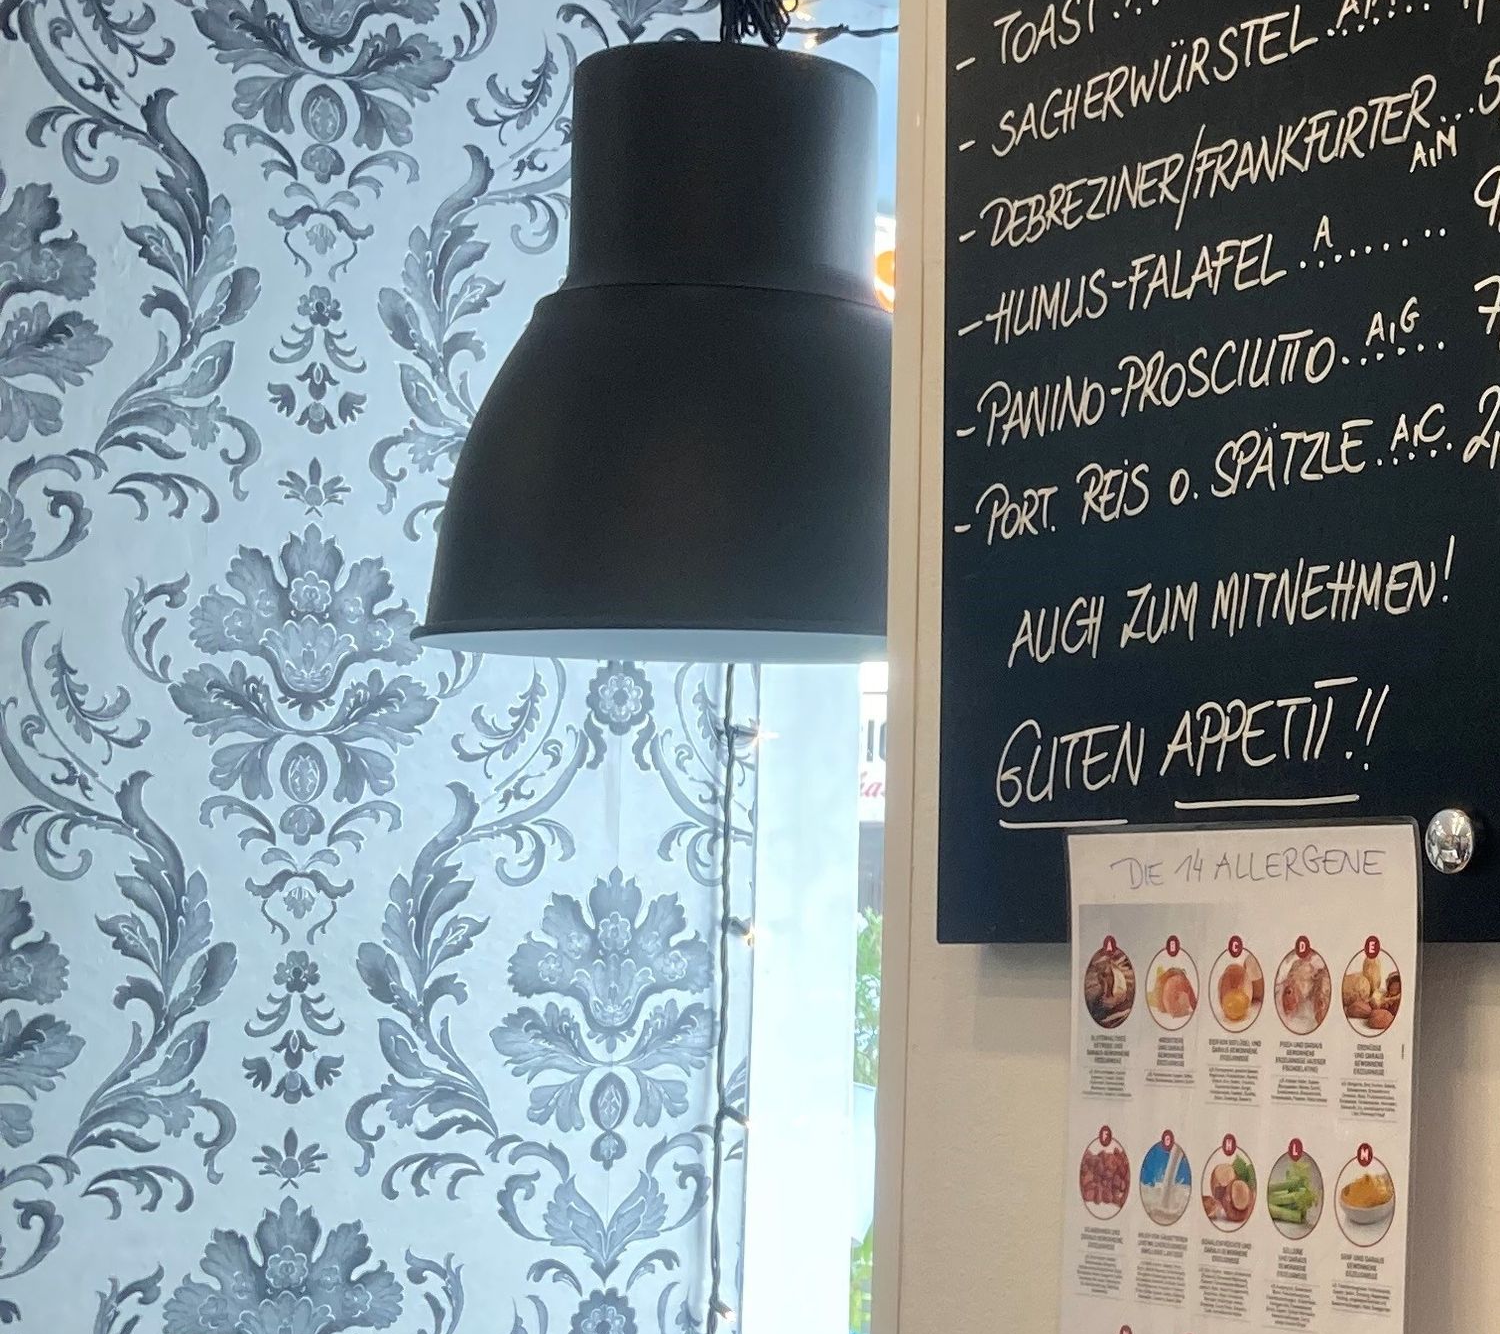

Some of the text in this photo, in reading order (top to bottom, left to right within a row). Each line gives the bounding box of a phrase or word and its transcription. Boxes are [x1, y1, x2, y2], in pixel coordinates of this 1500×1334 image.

[993, 6, 1318, 157] SACHERWÜRSTEL
[980, 74, 1436, 248] DEBREZINER/FRANKFURTER
[1076, 459, 1149, 526] REIS
[1211, 419, 1373, 498] SPÄTZLE
[1008, 534, 1456, 669] AUCH ZUM MITNEHMEN!
[995, 719, 1145, 810] GUTEN
[1110, 844, 1387, 889] DIE 14 ALLERGENE
